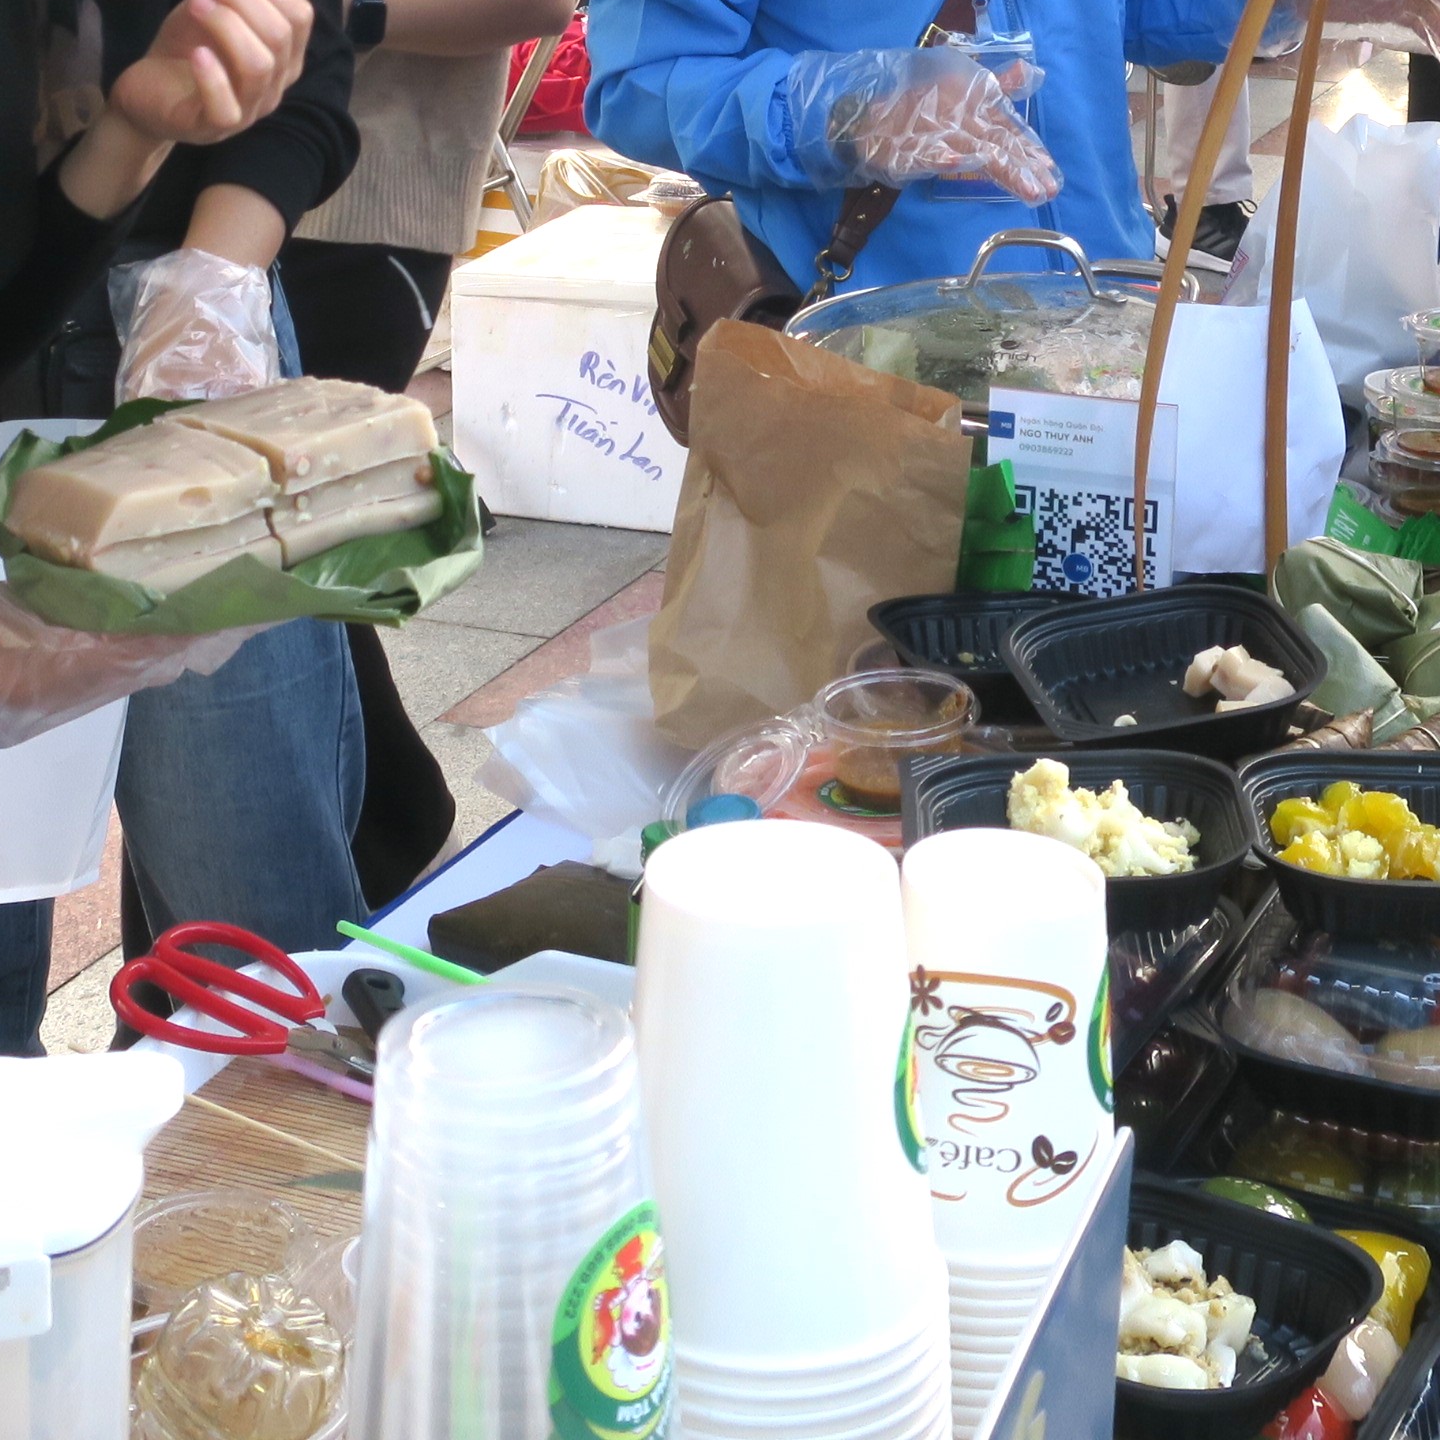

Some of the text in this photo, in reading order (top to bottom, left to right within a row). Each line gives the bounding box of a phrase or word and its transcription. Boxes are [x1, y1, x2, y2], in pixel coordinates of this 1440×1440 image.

[579, 351, 626, 395] Rèn
[1019, 428, 1094, 444] NGO THUY ANH
[619, 431, 663, 481] Lan
[941, 1140, 1022, 1174] Café
